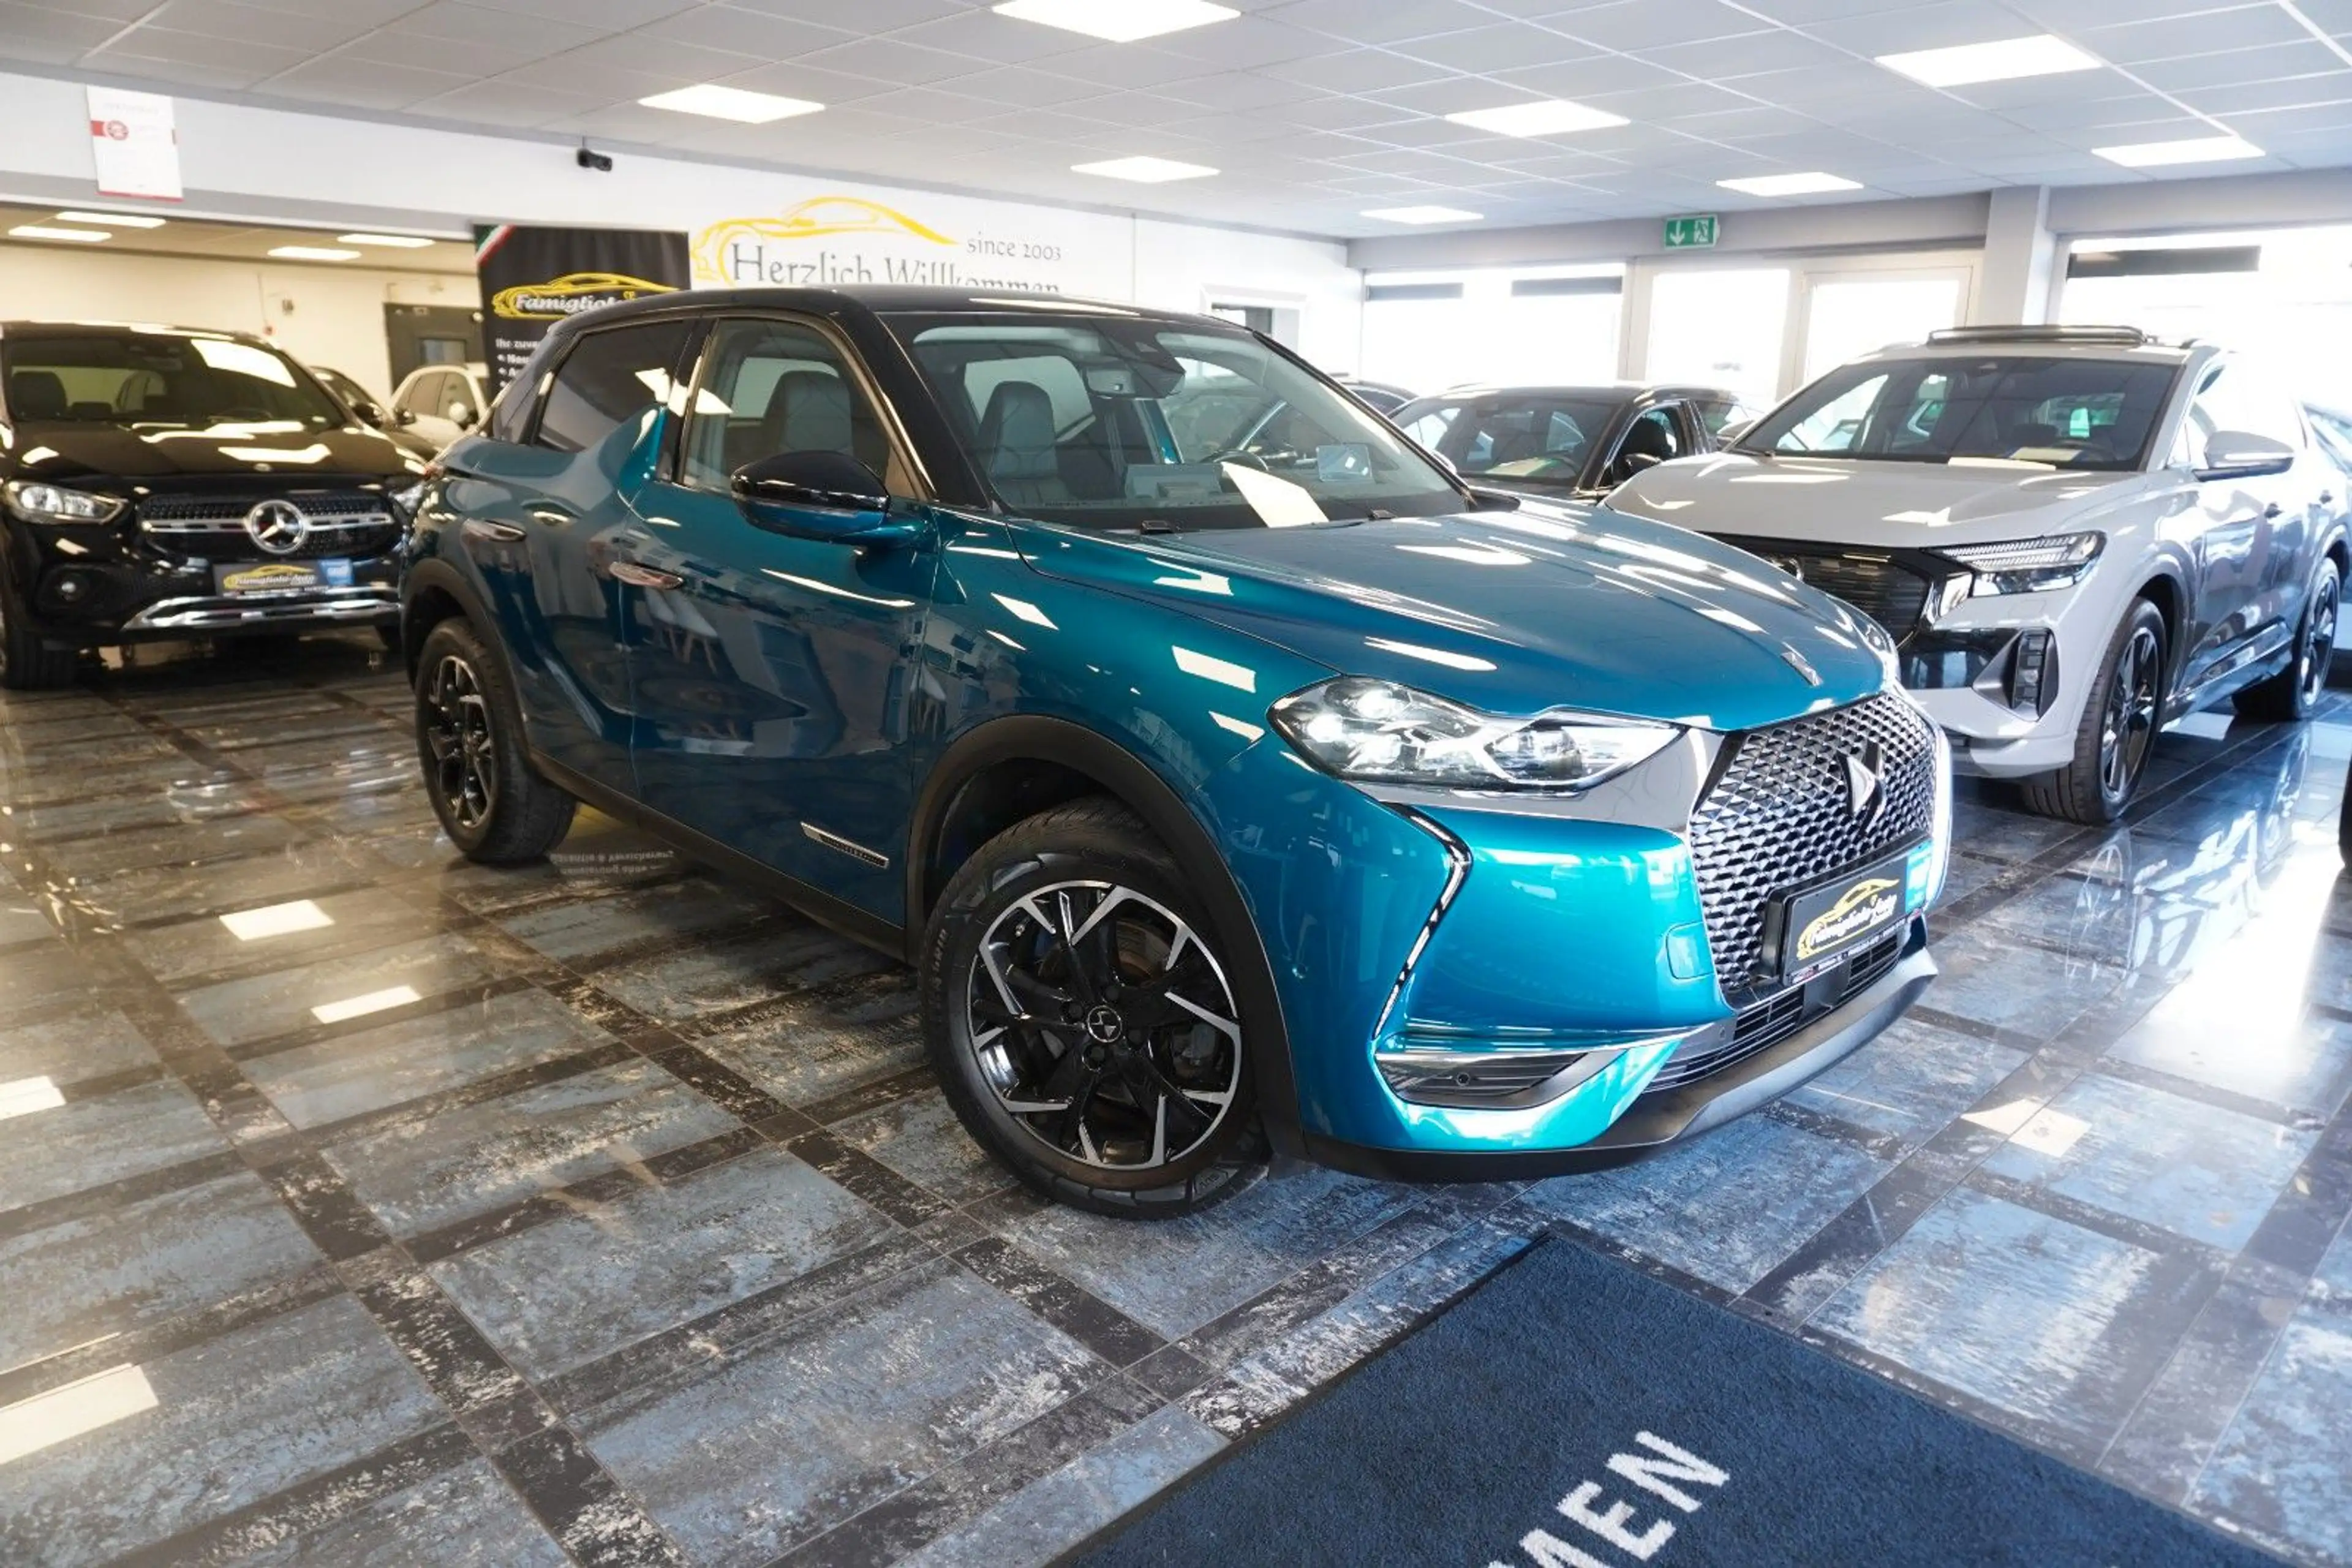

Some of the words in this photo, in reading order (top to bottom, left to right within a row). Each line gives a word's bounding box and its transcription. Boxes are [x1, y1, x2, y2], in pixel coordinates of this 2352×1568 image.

[731, 243, 873, 284] Herzlich
[967, 230, 1016, 257] since
[1023, 243, 1061, 261] 2003
